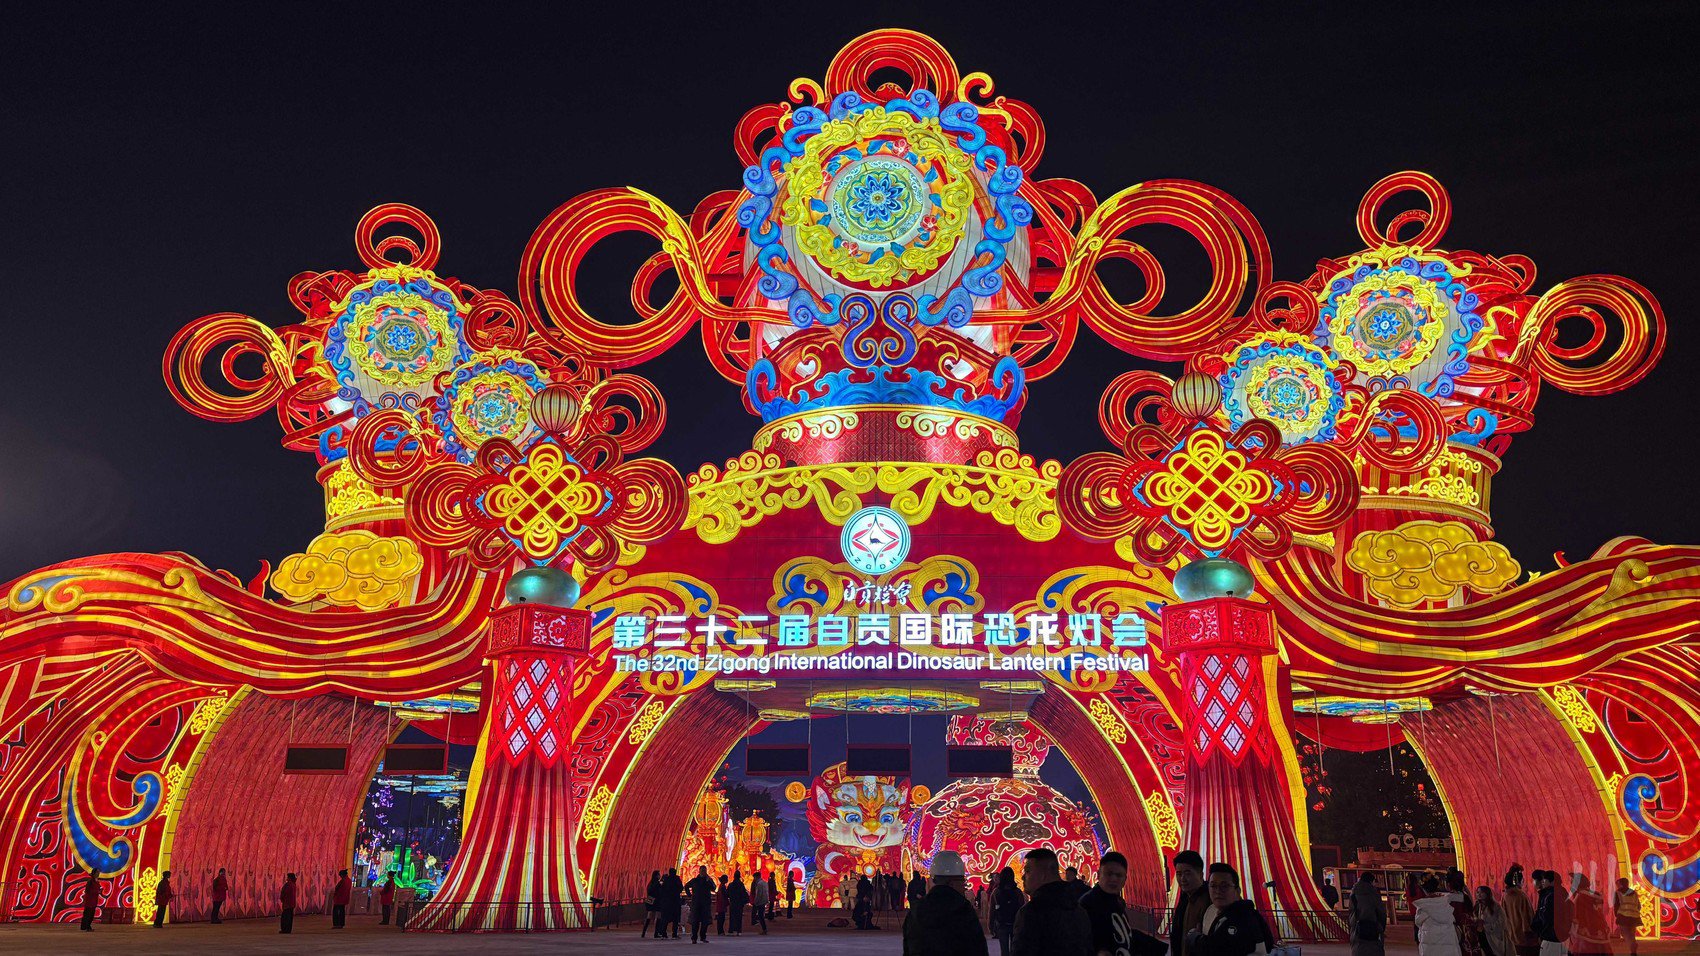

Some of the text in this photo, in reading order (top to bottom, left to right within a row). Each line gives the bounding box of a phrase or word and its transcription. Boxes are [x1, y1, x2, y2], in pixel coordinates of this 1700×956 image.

[613, 613, 1147, 648] 第三十二届自贡国际恐龙灯会
[612, 652, 1149, 674] The 32nd Zigong International Dinosaur Lantern Festival
